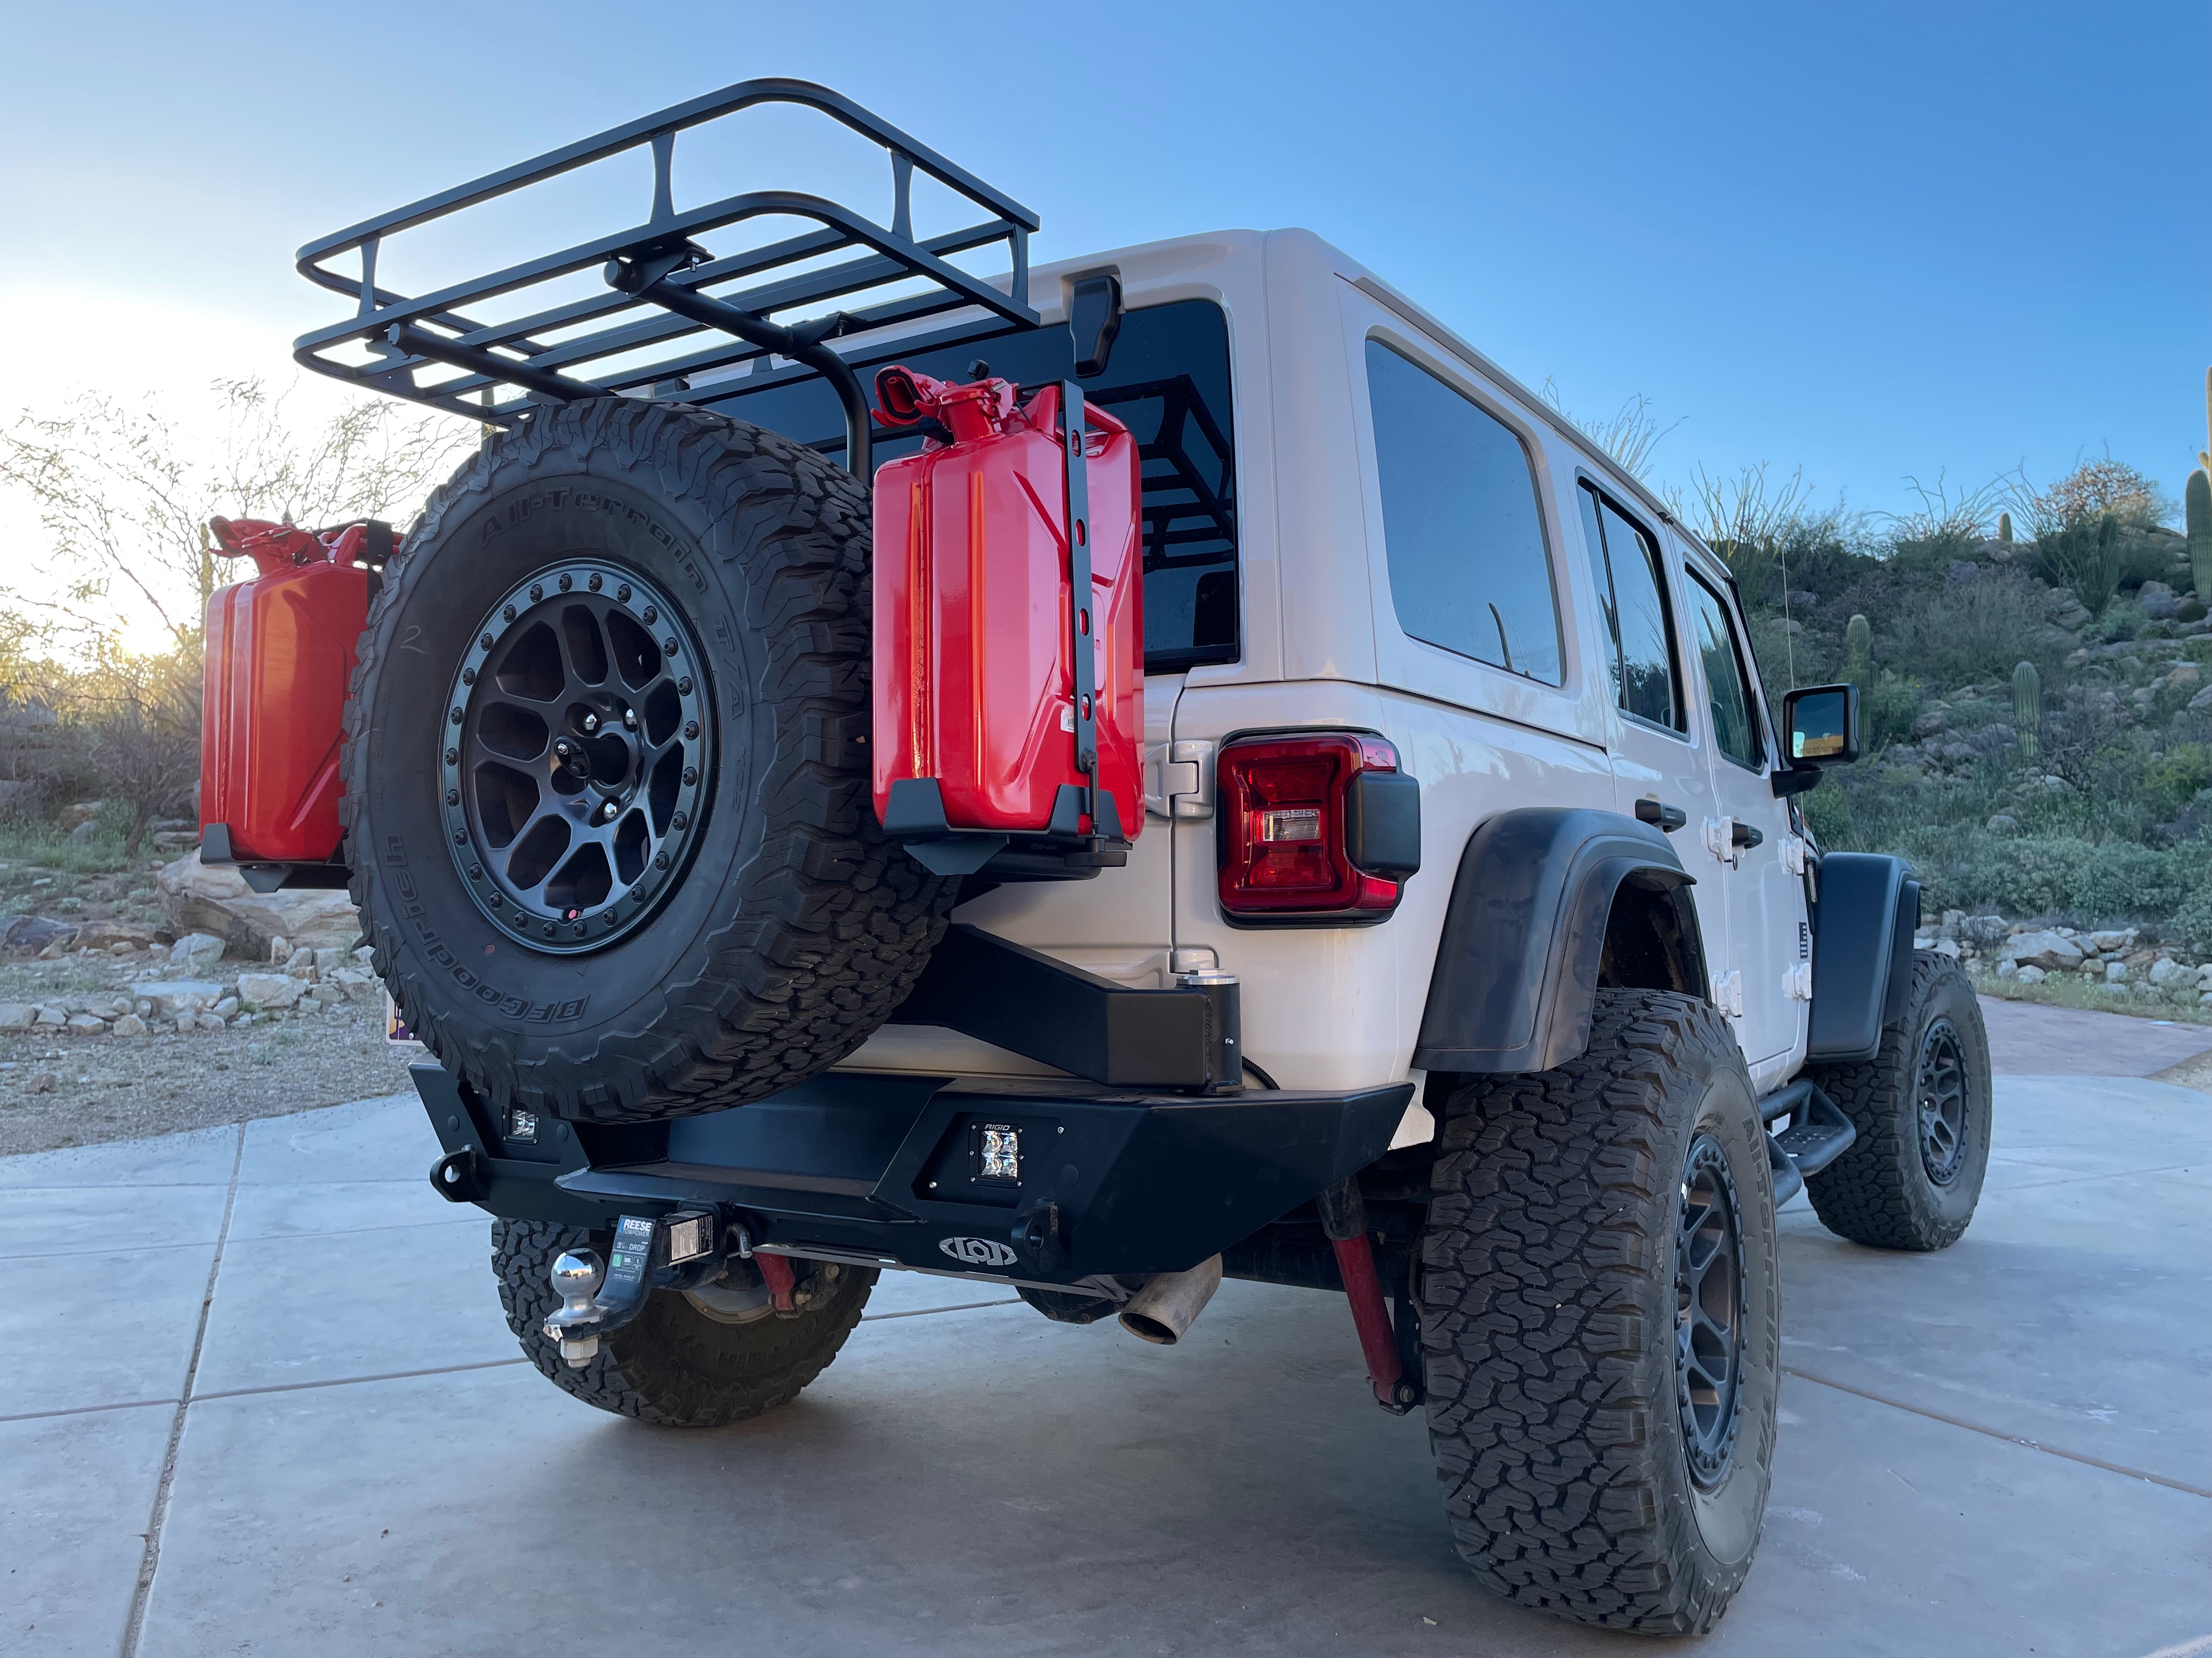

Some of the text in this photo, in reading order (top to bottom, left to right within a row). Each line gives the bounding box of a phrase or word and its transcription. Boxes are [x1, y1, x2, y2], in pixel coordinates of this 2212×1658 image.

[481, 486, 708, 595] All-Terrain
[713, 613, 744, 720] T/A
[399, 625, 427, 655] 2
[385, 834, 591, 1024] BFGoodrich
[623, 1219, 652, 1232] REESE
[623, 1228, 650, 1238] TOWPOWER
[629, 1243, 646, 1251] DROP
[1742, 1117, 1777, 1373] All-Terrain
